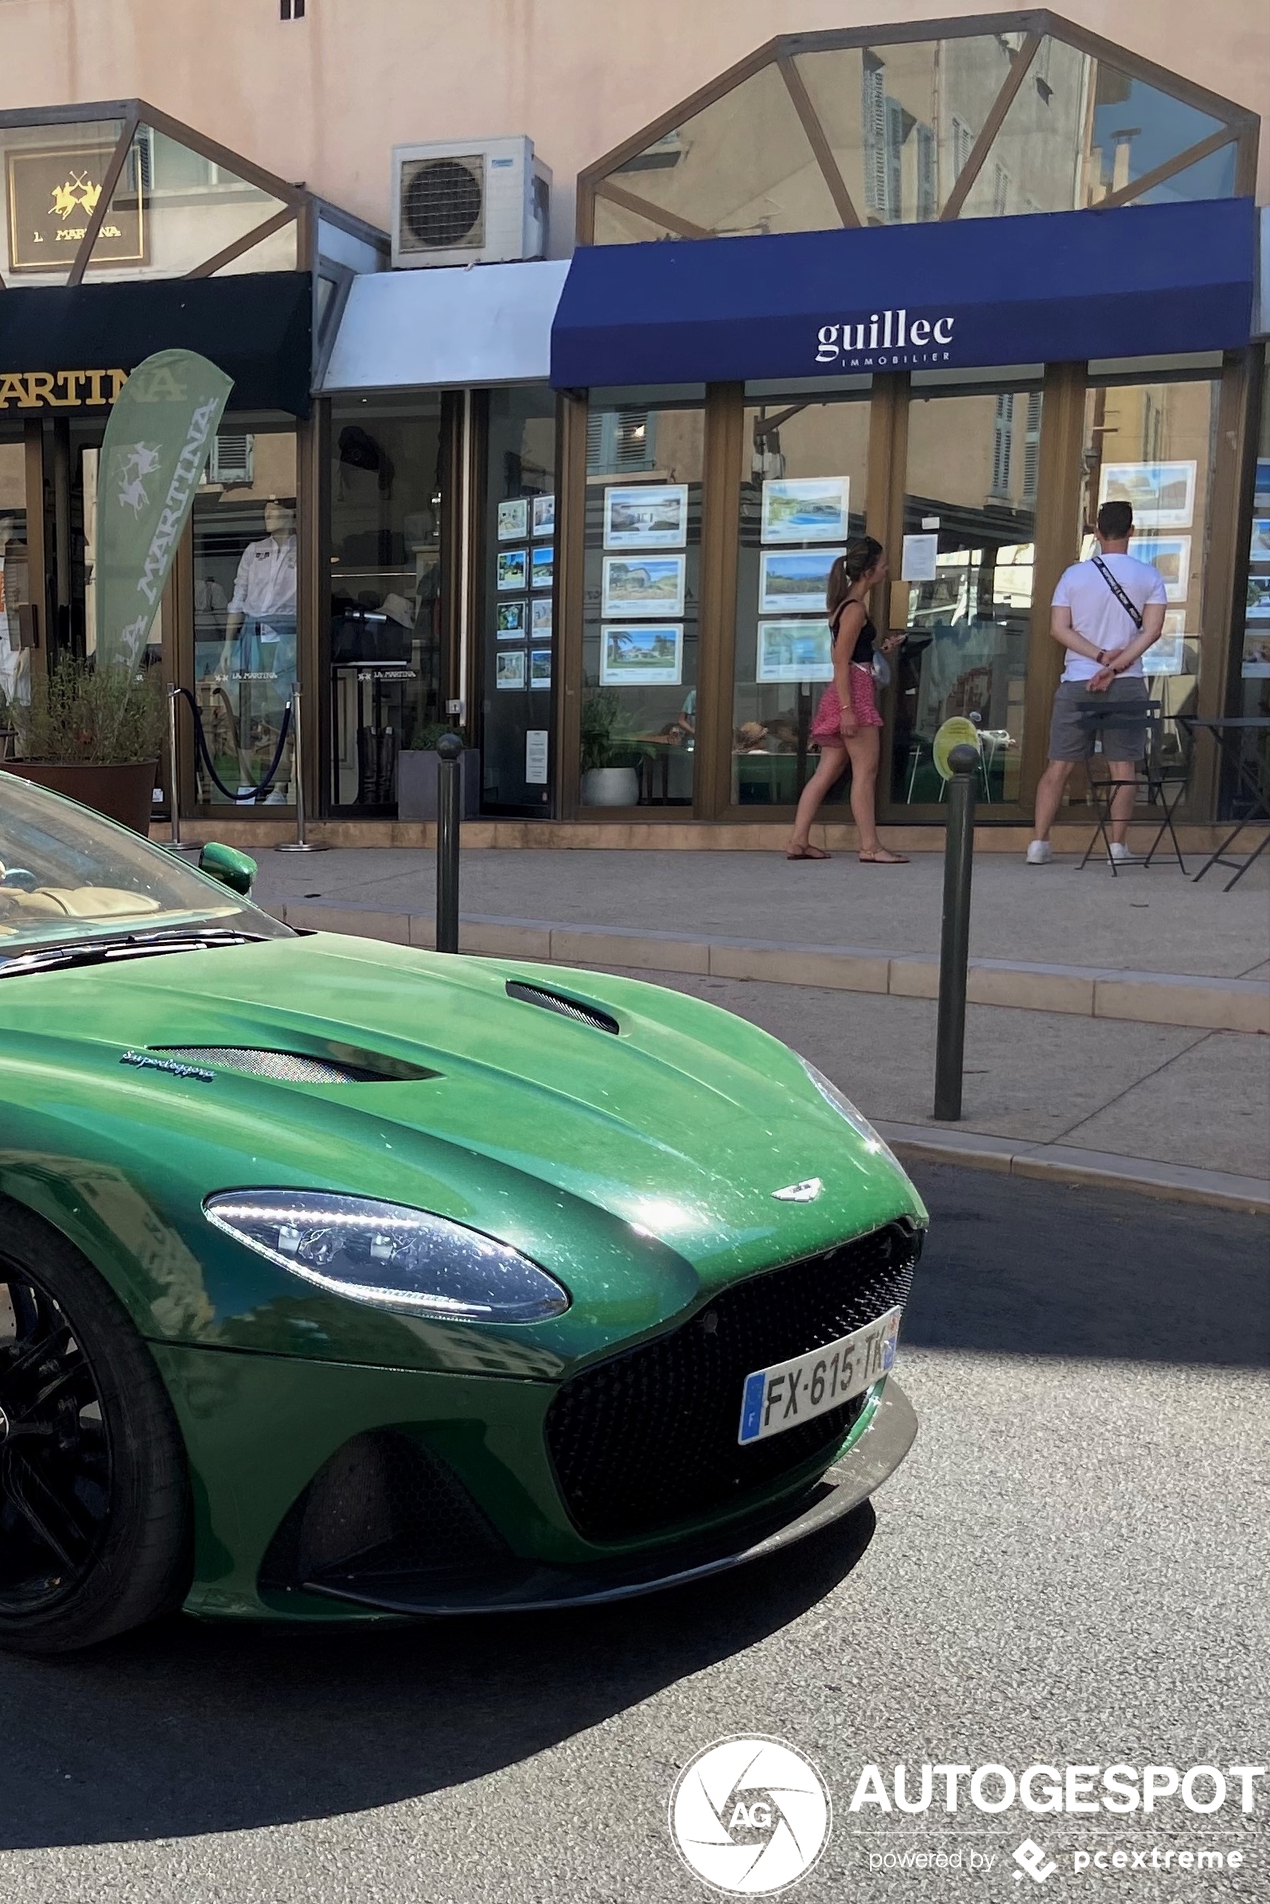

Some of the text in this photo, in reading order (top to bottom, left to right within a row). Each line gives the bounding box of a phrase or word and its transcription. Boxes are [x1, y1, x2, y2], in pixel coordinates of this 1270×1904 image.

[55, 226, 122, 241] MARNA
[815, 309, 955, 363] guillec
[842, 352, 950, 367] IMMOBILIER
[136, 397, 219, 605] MARTINA
[243, 671, 278, 680] MARTINA
[384, 670, 417, 678] MARTINA
